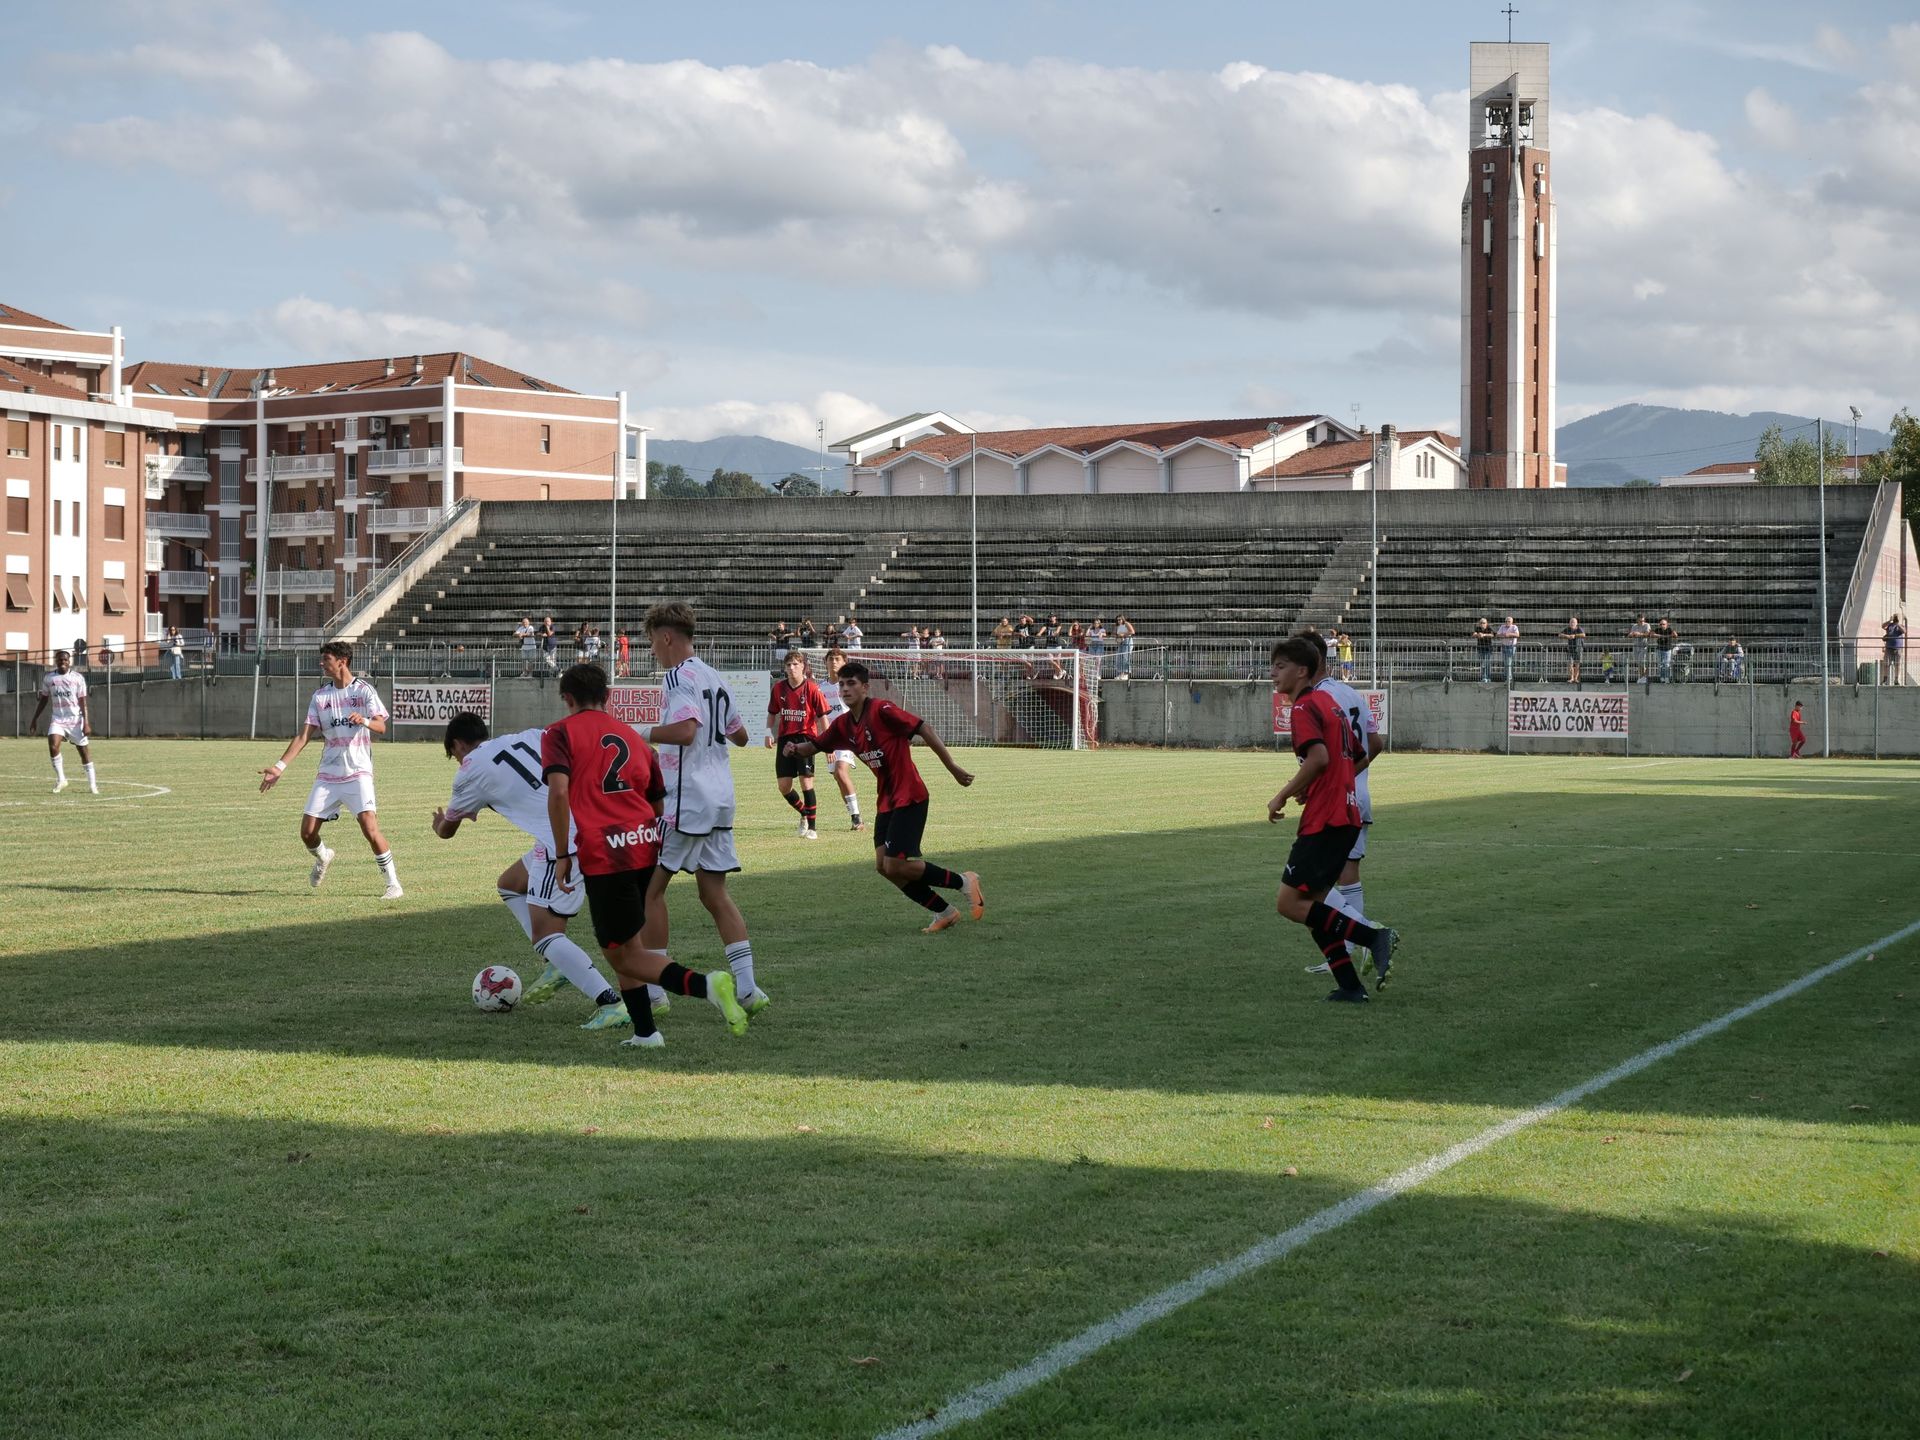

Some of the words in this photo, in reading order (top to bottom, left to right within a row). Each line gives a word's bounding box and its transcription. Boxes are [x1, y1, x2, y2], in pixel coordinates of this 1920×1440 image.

[395, 688, 432, 704] FORZA
[436, 689, 487, 704] RAGAZZI
[610, 688, 662, 705] QUEST
[395, 705, 435, 720] SIAMO
[438, 706, 463, 720] CON
[612, 706, 661, 722] MOND
[1513, 697, 1558, 713] FORZA
[1562, 697, 1624, 714] RAGAZZI
[702, 687, 730, 747] 10
[1513, 715, 1561, 731] SIAMO
[1566, 715, 1595, 732] CON
[1600, 716, 1624, 732] VOI
[492, 741, 543, 791] 11
[600, 733, 635, 795] 2
[606, 824, 659, 849] wefox
